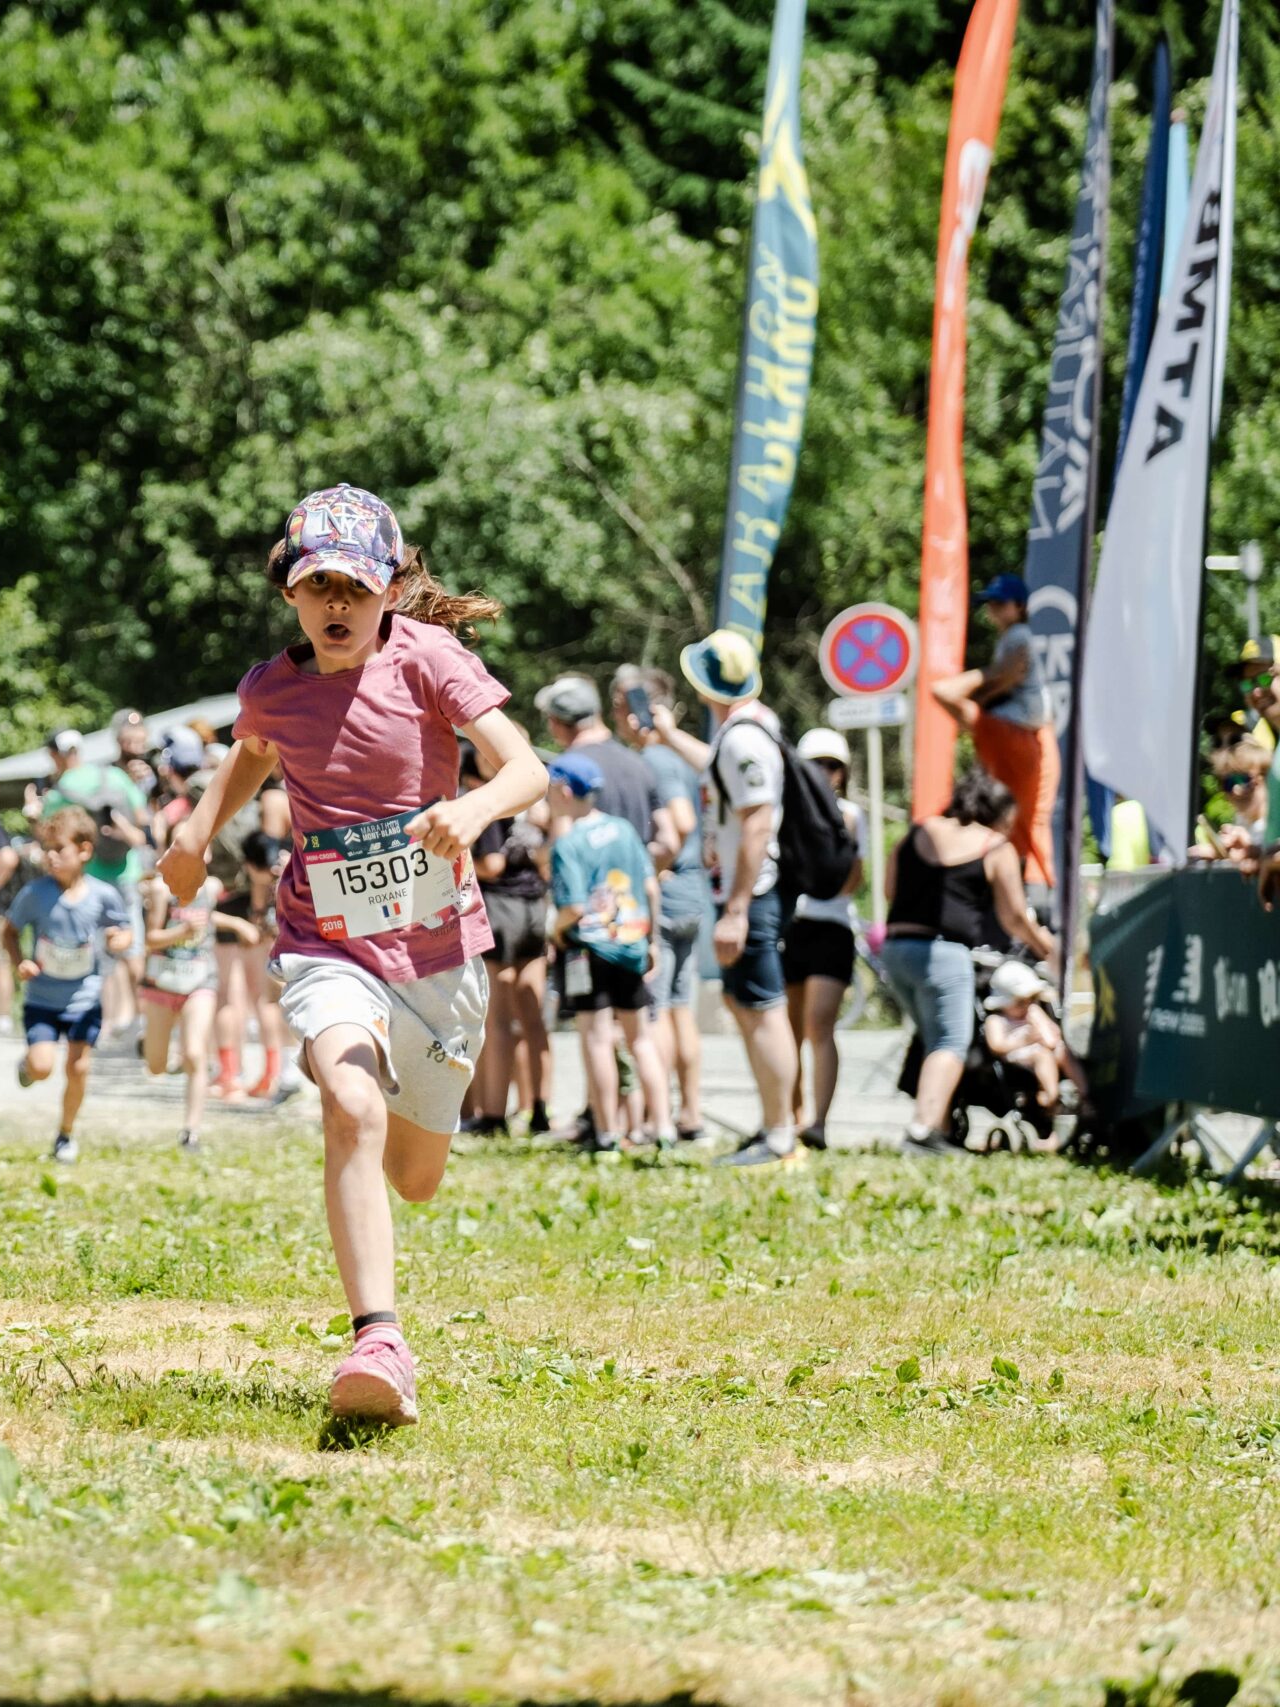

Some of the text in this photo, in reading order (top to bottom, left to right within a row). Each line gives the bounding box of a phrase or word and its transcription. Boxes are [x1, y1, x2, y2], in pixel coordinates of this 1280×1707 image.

[362, 826, 401, 841] MONT-BLANC
[332, 848, 429, 896] 15303
[368, 888, 408, 905] ROXANE
[322, 920, 343, 931] 2018
